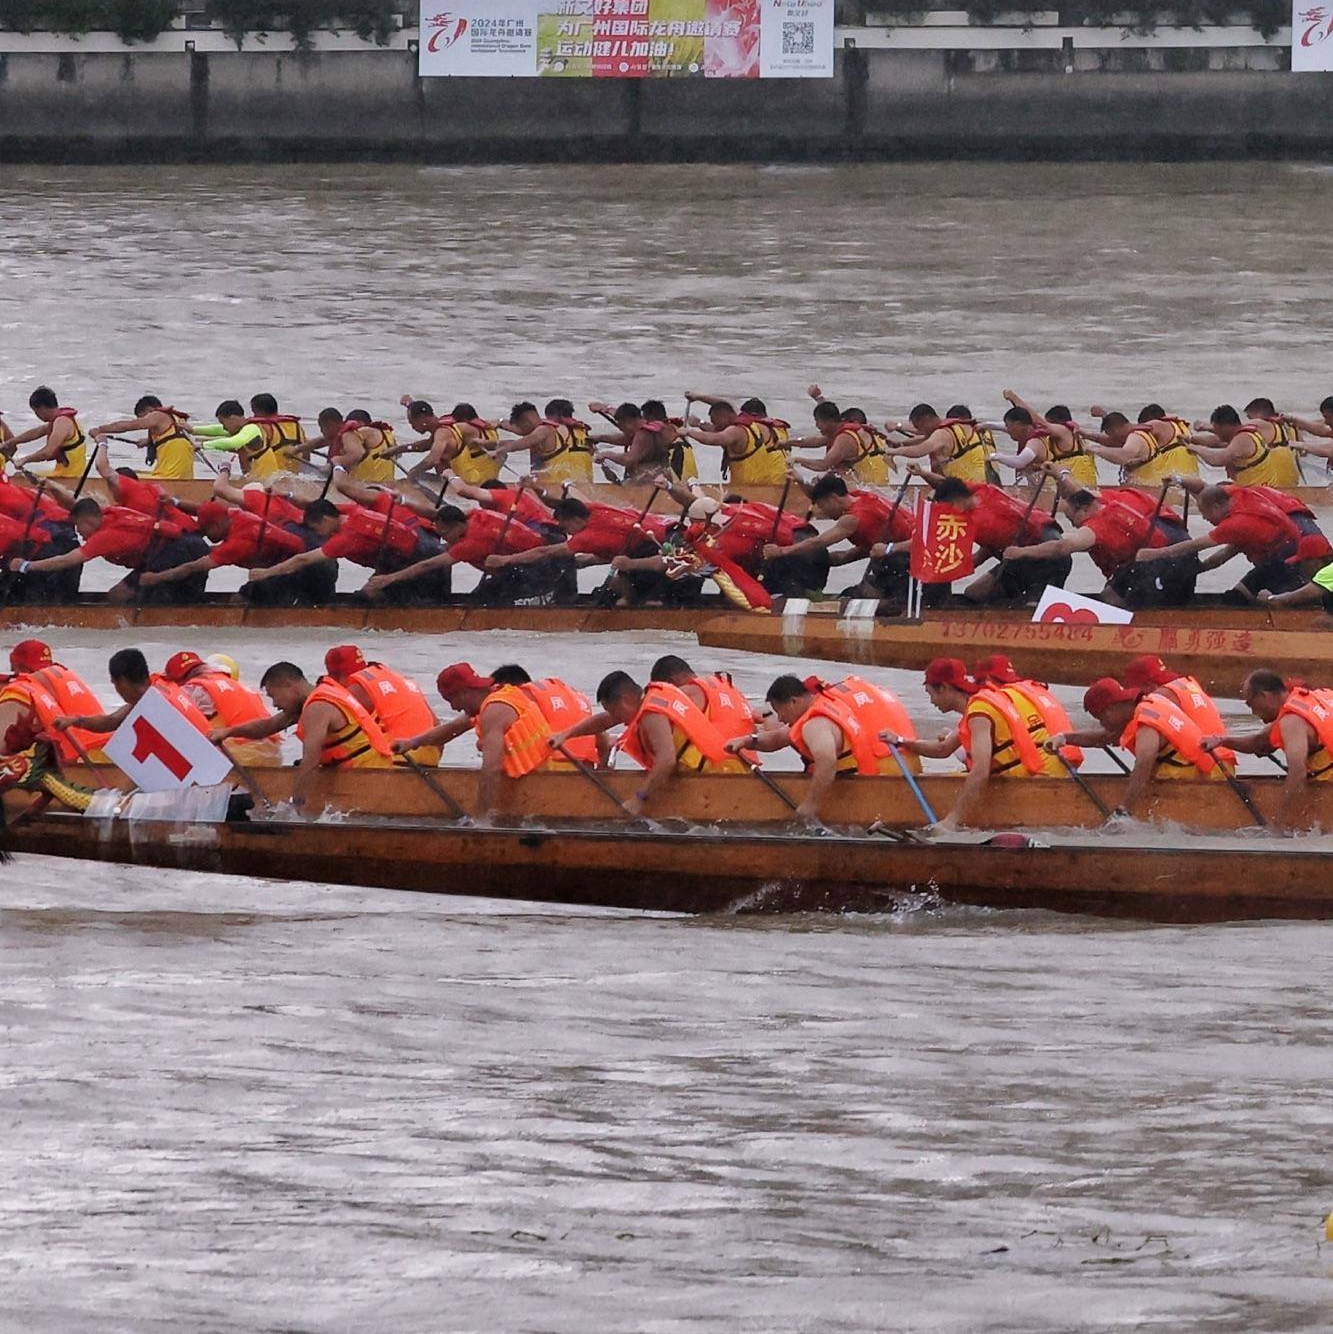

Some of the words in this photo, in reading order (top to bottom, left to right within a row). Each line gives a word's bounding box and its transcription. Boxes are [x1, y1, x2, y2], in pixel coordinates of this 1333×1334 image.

[557, 20, 742, 37] 为广州国际龙舟邀请赛
[935, 513, 968, 574] 赤沙
[131, 714, 194, 782] 1
